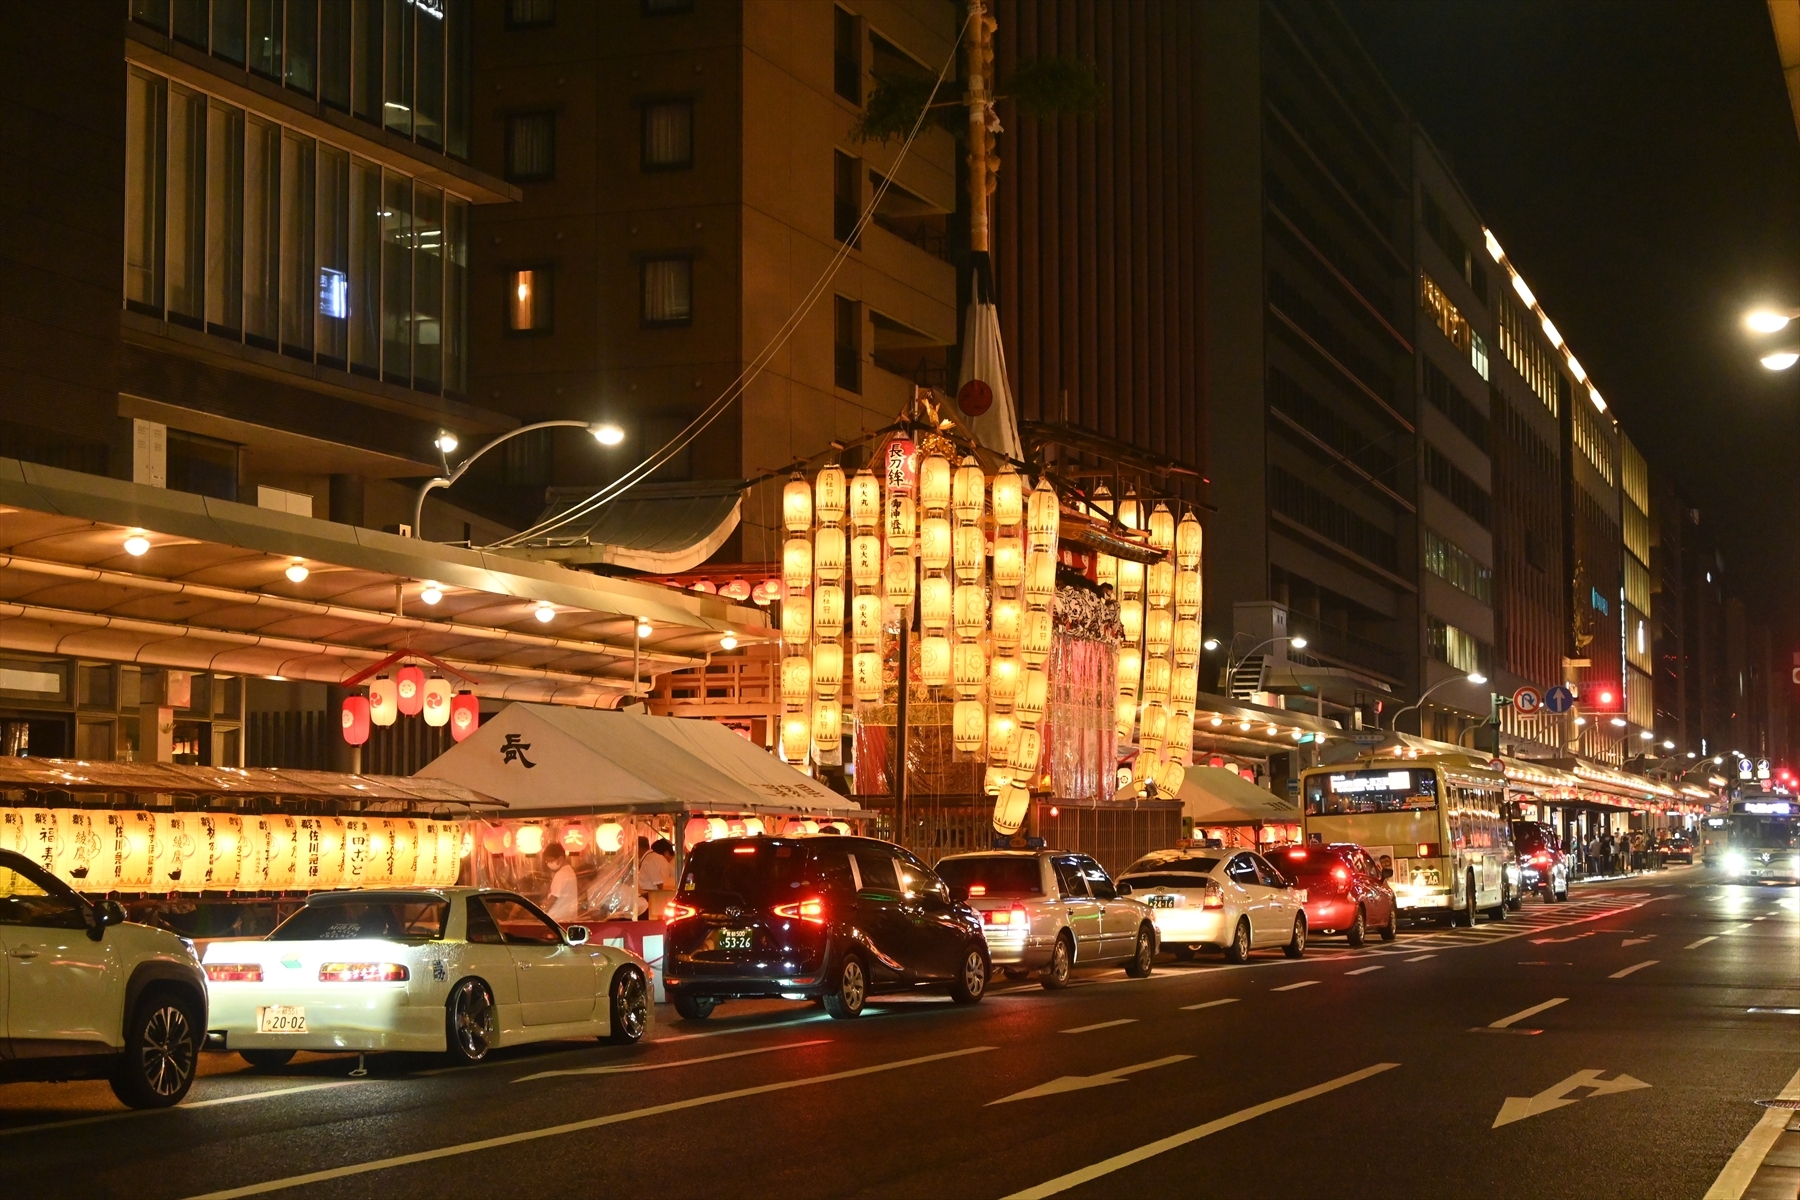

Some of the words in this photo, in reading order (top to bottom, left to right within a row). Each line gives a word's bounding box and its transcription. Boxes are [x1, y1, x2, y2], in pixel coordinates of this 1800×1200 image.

[888, 443, 904, 487] 長刀鉾
[114, 825, 123, 878] 佐川急便
[308, 830, 319, 877] 佐川急便
[1153, 900, 1173, 909] 24-16
[725, 937, 751, 948] 53-26
[272, 1016, 305, 1029] 20-02
